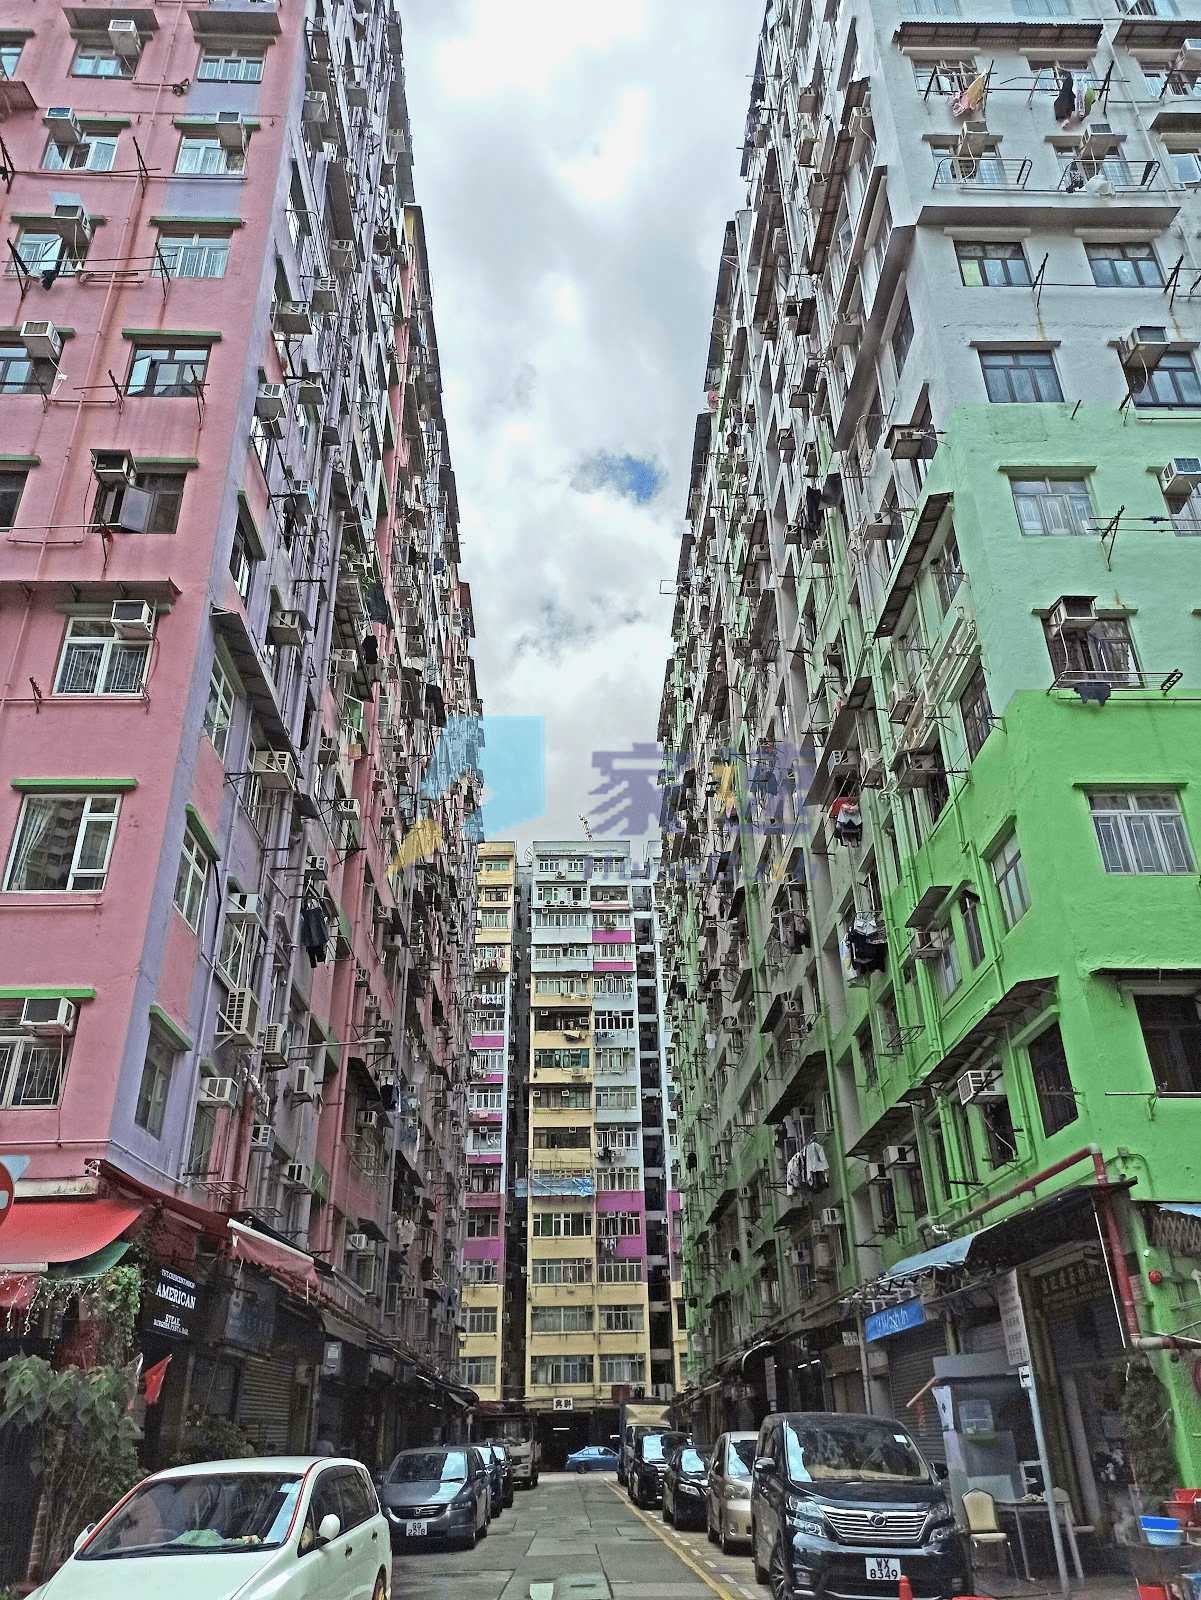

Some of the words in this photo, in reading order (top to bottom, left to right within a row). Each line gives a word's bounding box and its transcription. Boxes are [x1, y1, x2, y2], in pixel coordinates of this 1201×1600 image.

[155, 1282, 196, 1309] AMERICAN
[876, 1559, 889, 1569] WX
[870, 1568, 898, 1579] 8349
